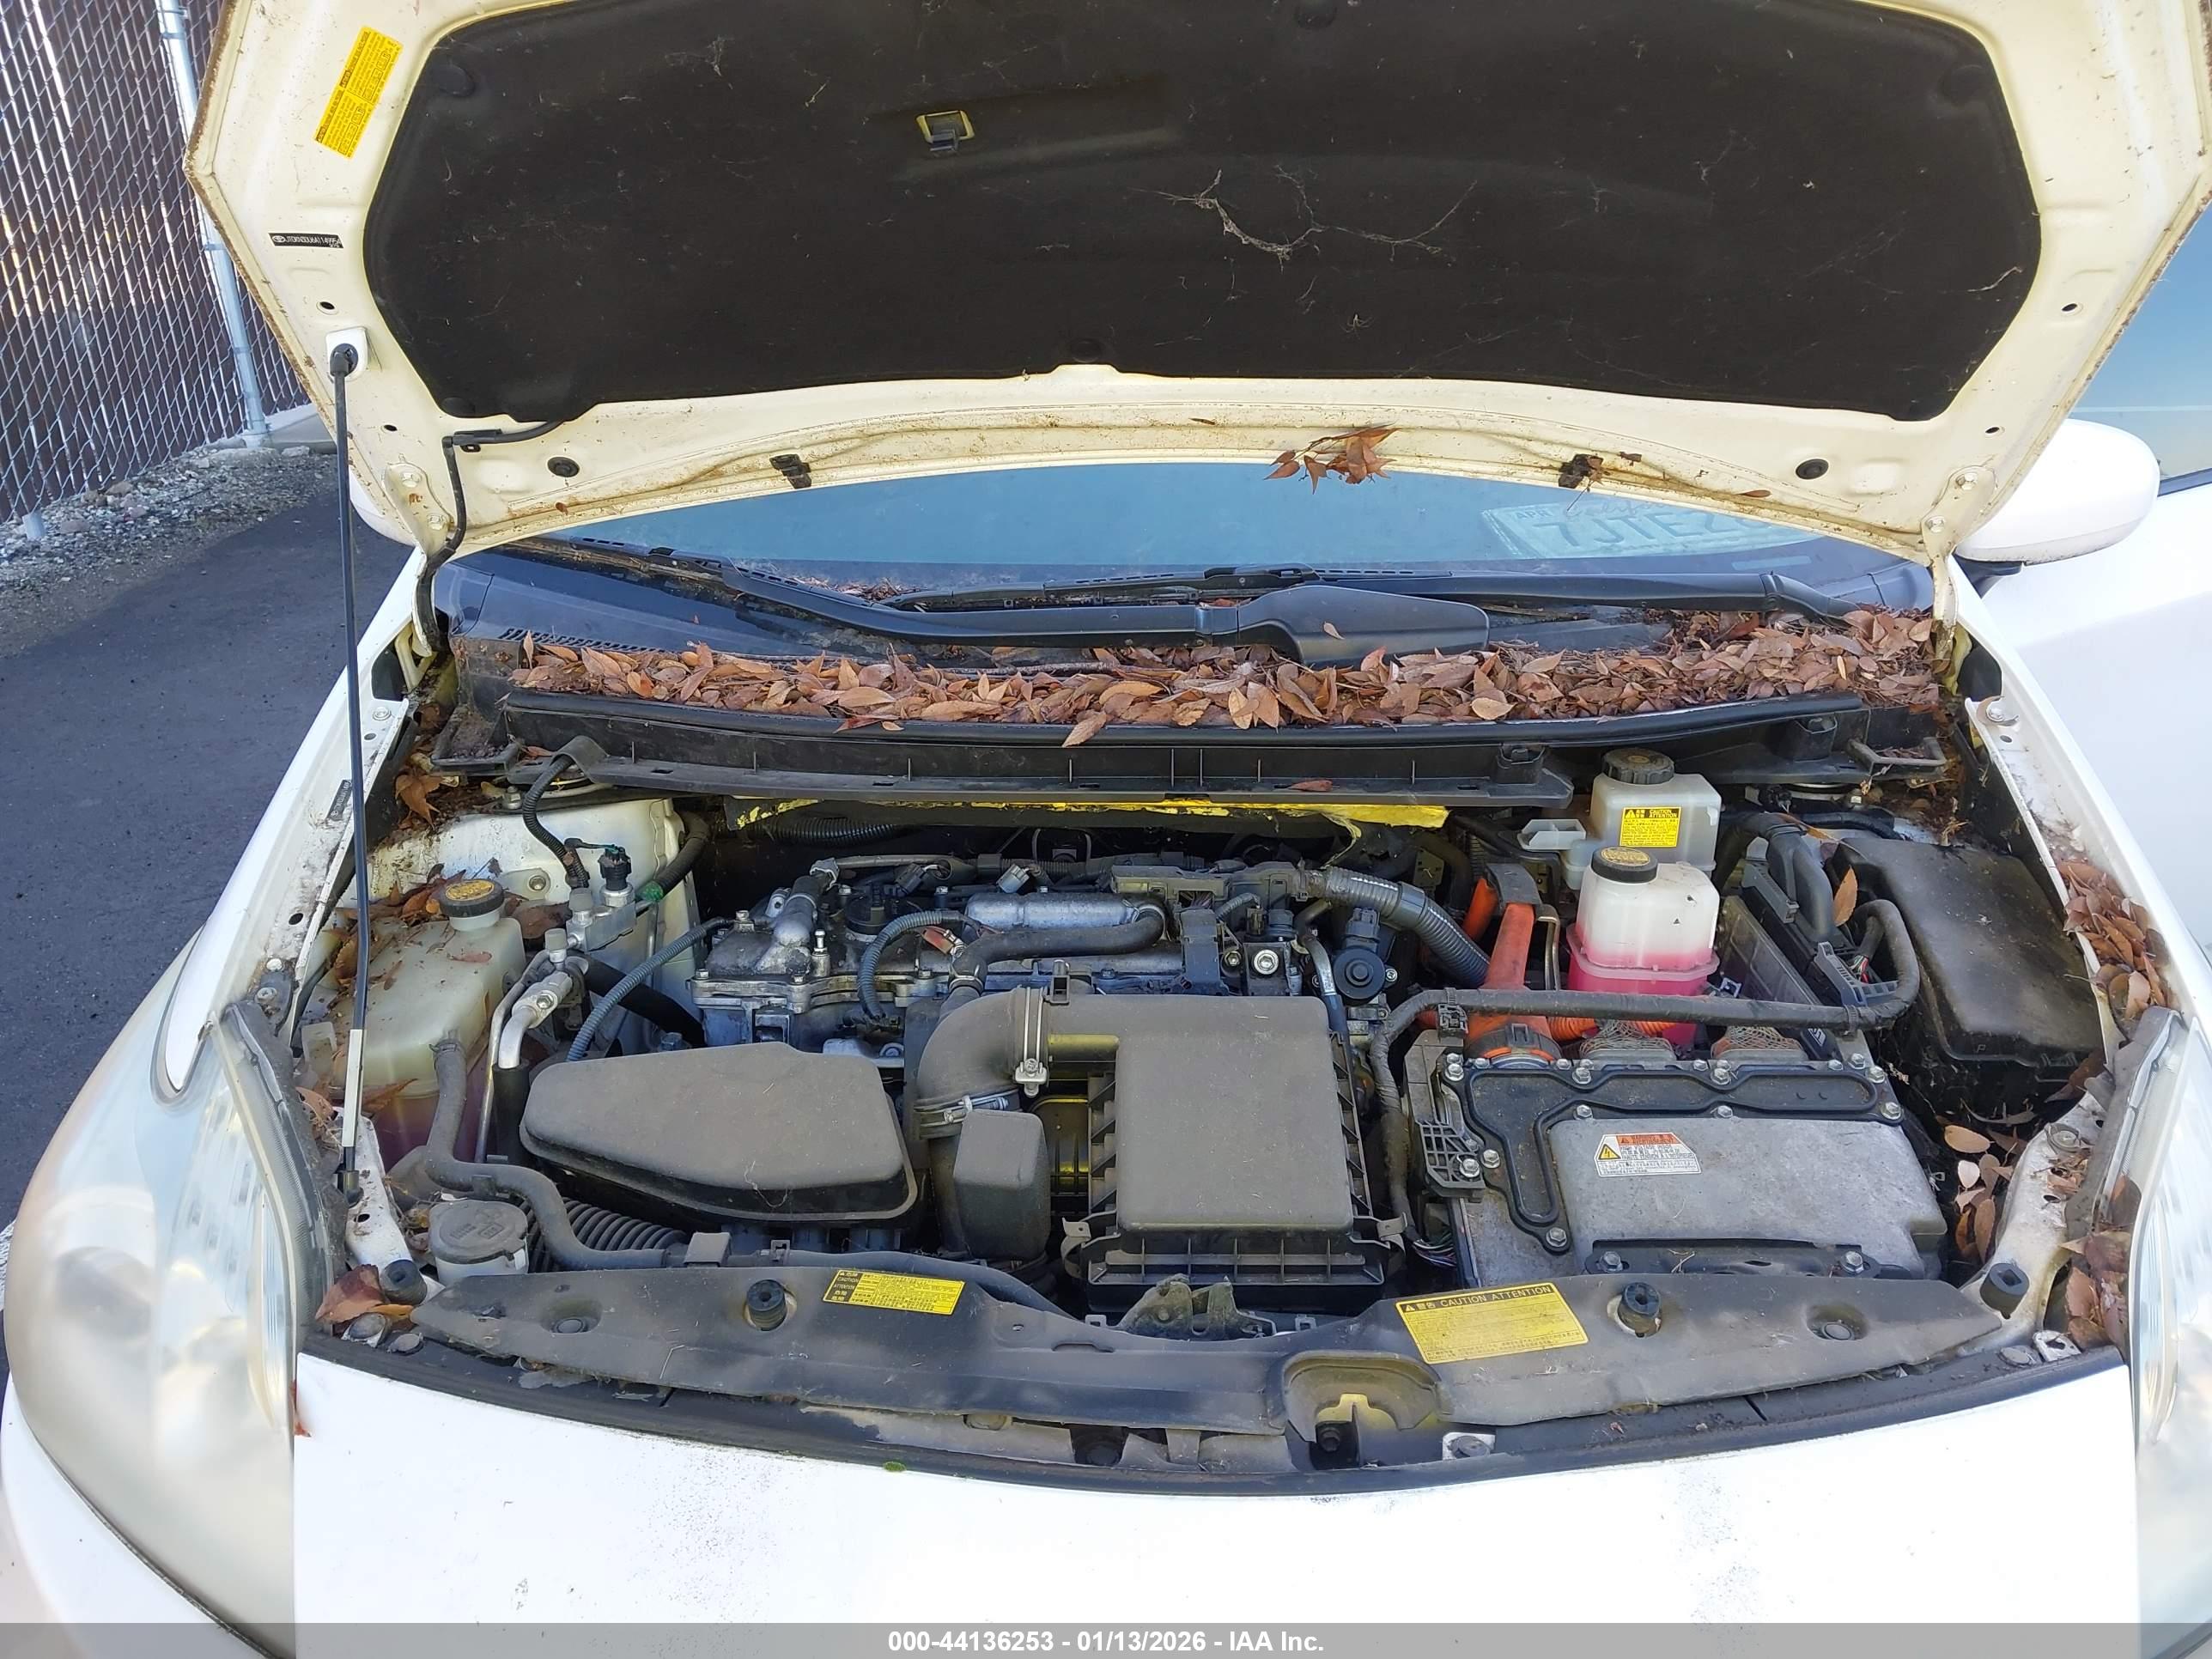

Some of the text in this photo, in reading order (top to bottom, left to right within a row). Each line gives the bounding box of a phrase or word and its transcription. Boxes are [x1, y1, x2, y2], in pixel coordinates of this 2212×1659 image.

[1515, 508, 1553, 520] APR
[1440, 1295, 1487, 1307] CAUTION
[1491, 1285, 1552, 1302] ATTENTION
